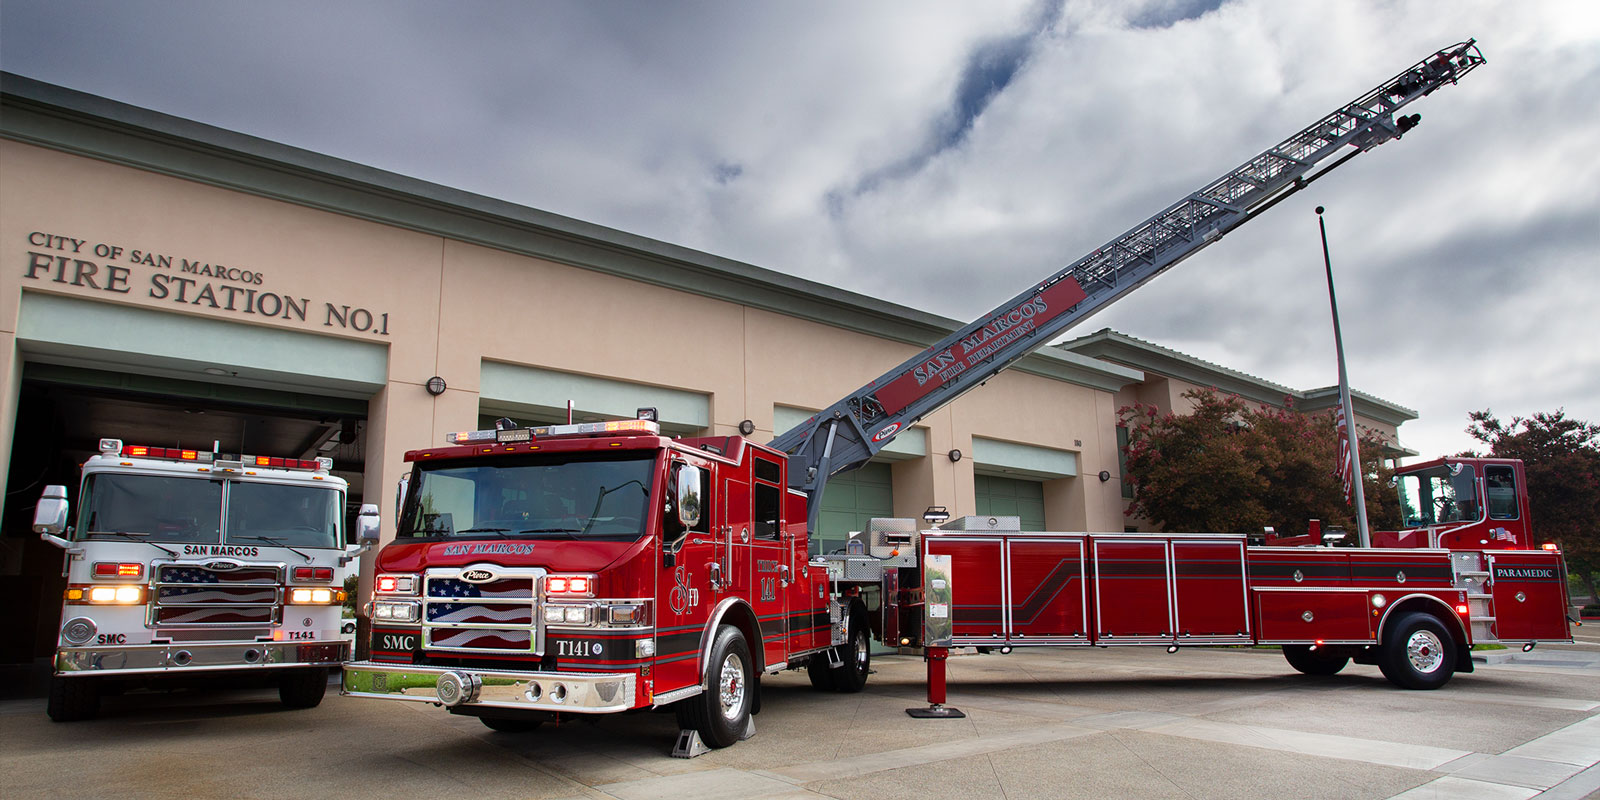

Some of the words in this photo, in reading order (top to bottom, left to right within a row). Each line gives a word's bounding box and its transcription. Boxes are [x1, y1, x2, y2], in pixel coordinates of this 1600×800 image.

[28, 231, 86, 253] CITY
[94, 243, 124, 260] OF
[130, 249, 173, 269] SAN
[181, 258, 264, 285] MARCOS
[24, 251, 131, 294] FIRE
[149, 273, 310, 322] STATION
[324, 302, 390, 335] NO.1
[914, 348, 955, 386] SAN
[959, 296, 1048, 354] MARCOS
[939, 361, 966, 382] FIRE
[966, 319, 1036, 365] DEPARTMENT
[183, 545, 208, 555] SAN
[210, 546, 259, 557] MARCOS
[443, 544, 472, 556] SAN
[472, 543, 535, 555] MARCOS
[466, 570, 490, 580] Pierce
[1497, 568, 1552, 577] PARAMEDIC
[760, 577, 776, 602] 141
[97, 633, 127, 645] SMC
[288, 631, 316, 640] T141
[383, 634, 415, 651] SMC
[556, 640, 590, 657] T141
